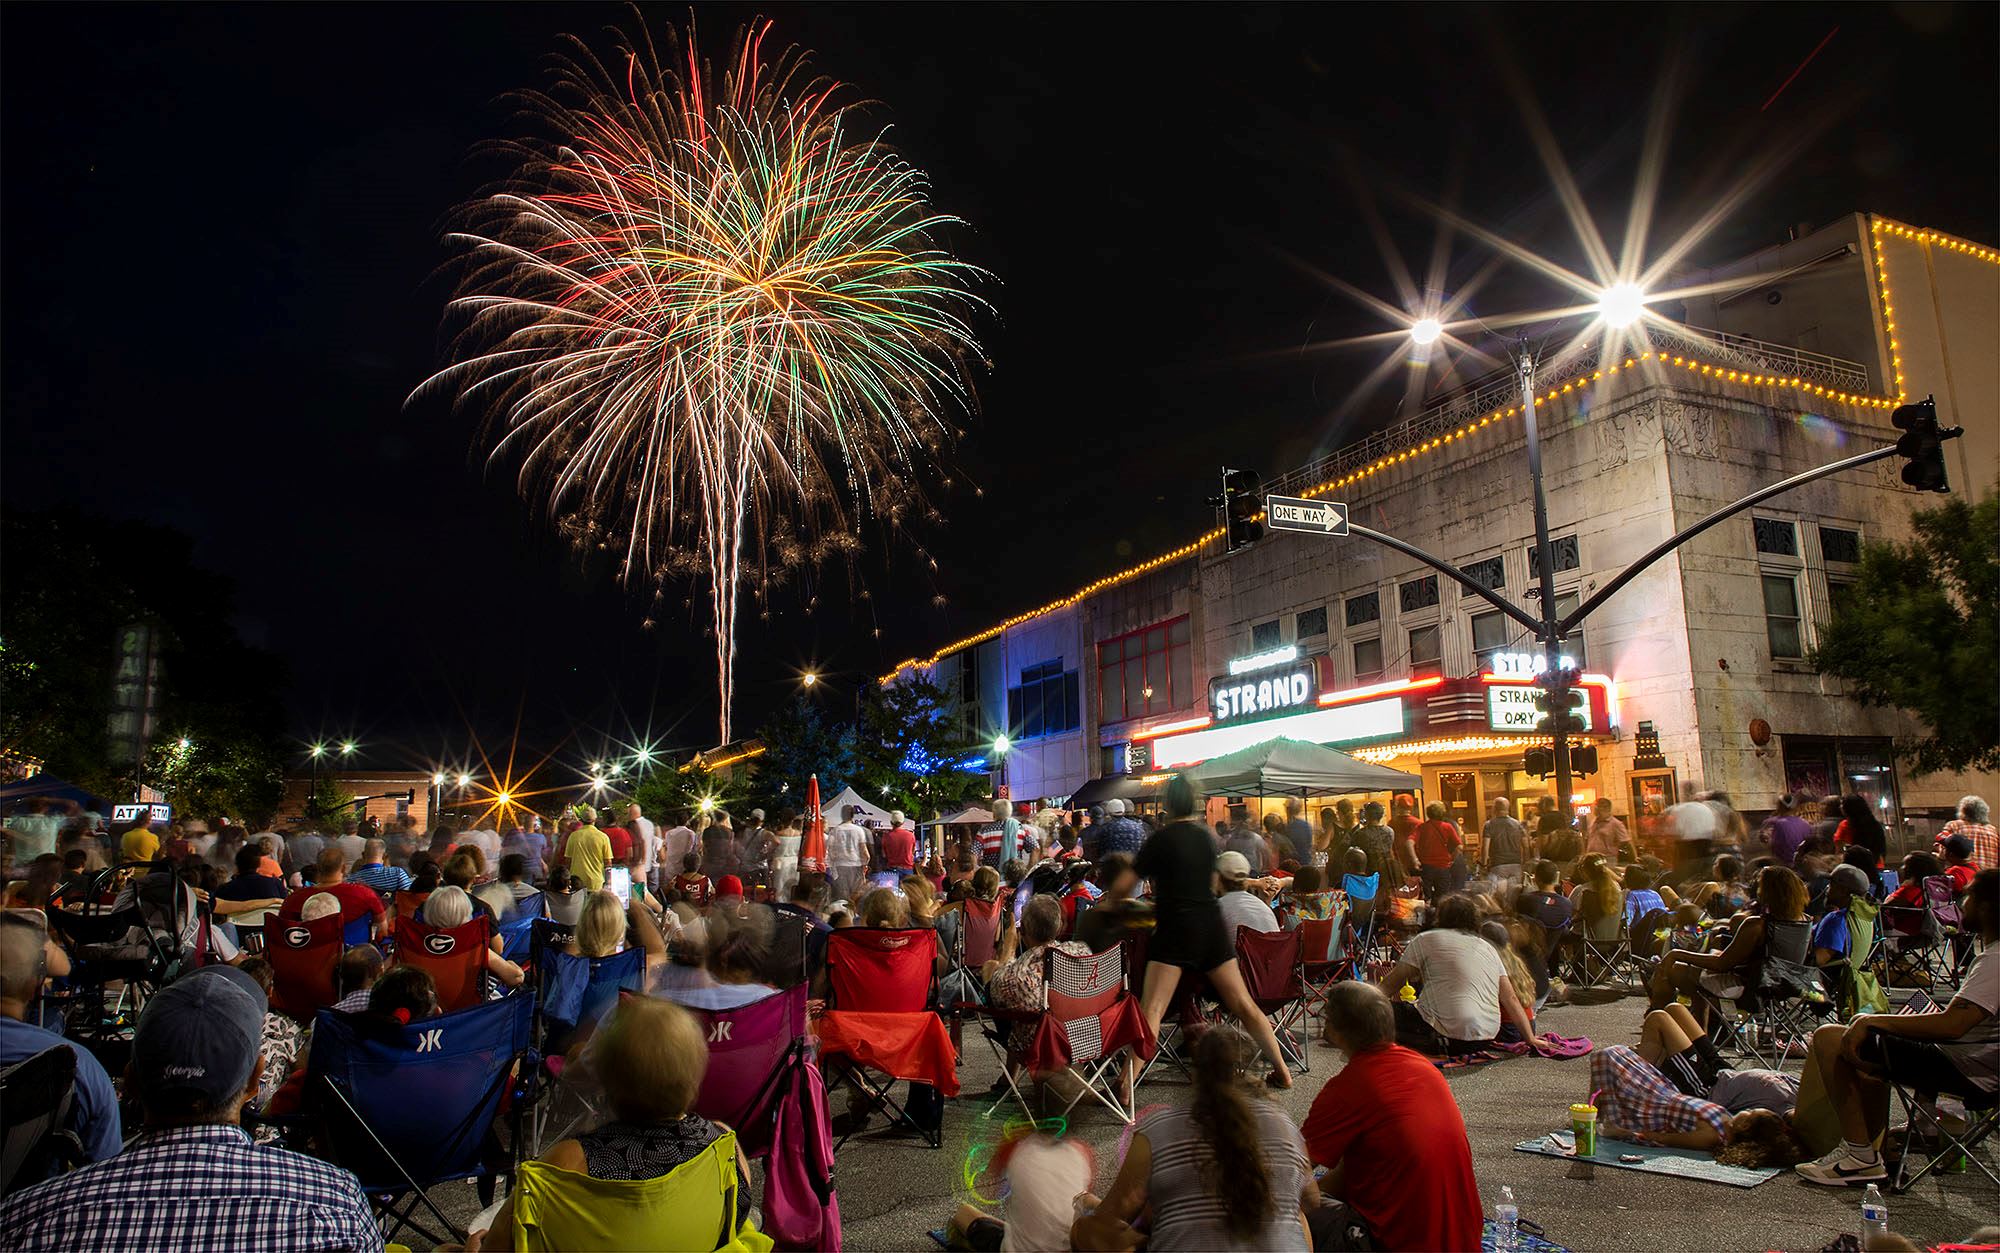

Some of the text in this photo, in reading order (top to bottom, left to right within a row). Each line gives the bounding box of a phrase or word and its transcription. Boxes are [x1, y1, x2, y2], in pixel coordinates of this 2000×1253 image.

[1480, 475, 1512, 499] BEST
[1275, 506, 1325, 523] ONE WAY
[1493, 653, 1576, 674] STRAD
[1216, 673, 1308, 719] STRAND
[1504, 711, 1535, 725] OPRY
[152, 808, 168, 819] ATM
[1079, 961, 1099, 991] A
[163, 1064, 206, 1079] Georgia
